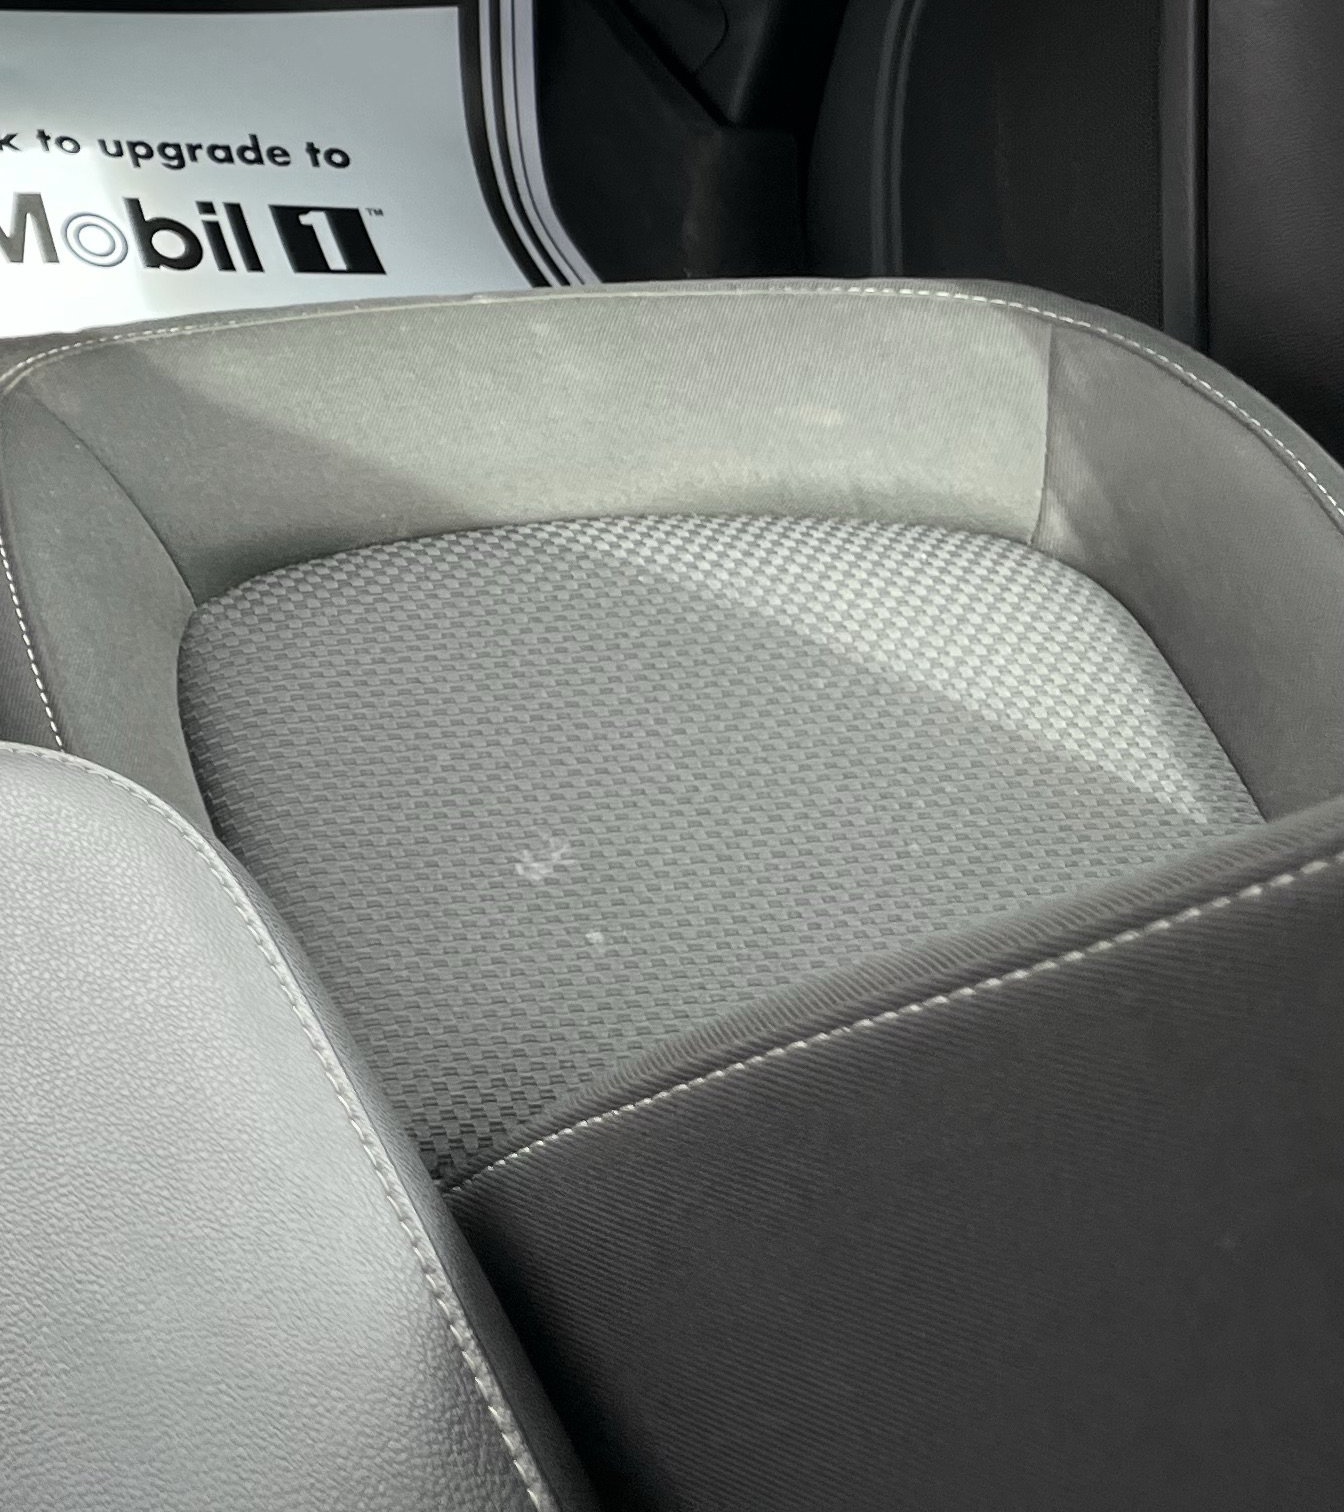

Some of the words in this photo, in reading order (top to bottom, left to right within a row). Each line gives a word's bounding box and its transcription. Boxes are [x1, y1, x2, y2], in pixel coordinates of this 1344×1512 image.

[36, 127, 82, 156] to
[98, 133, 292, 171] upgrade
[305, 140, 352, 170] to
